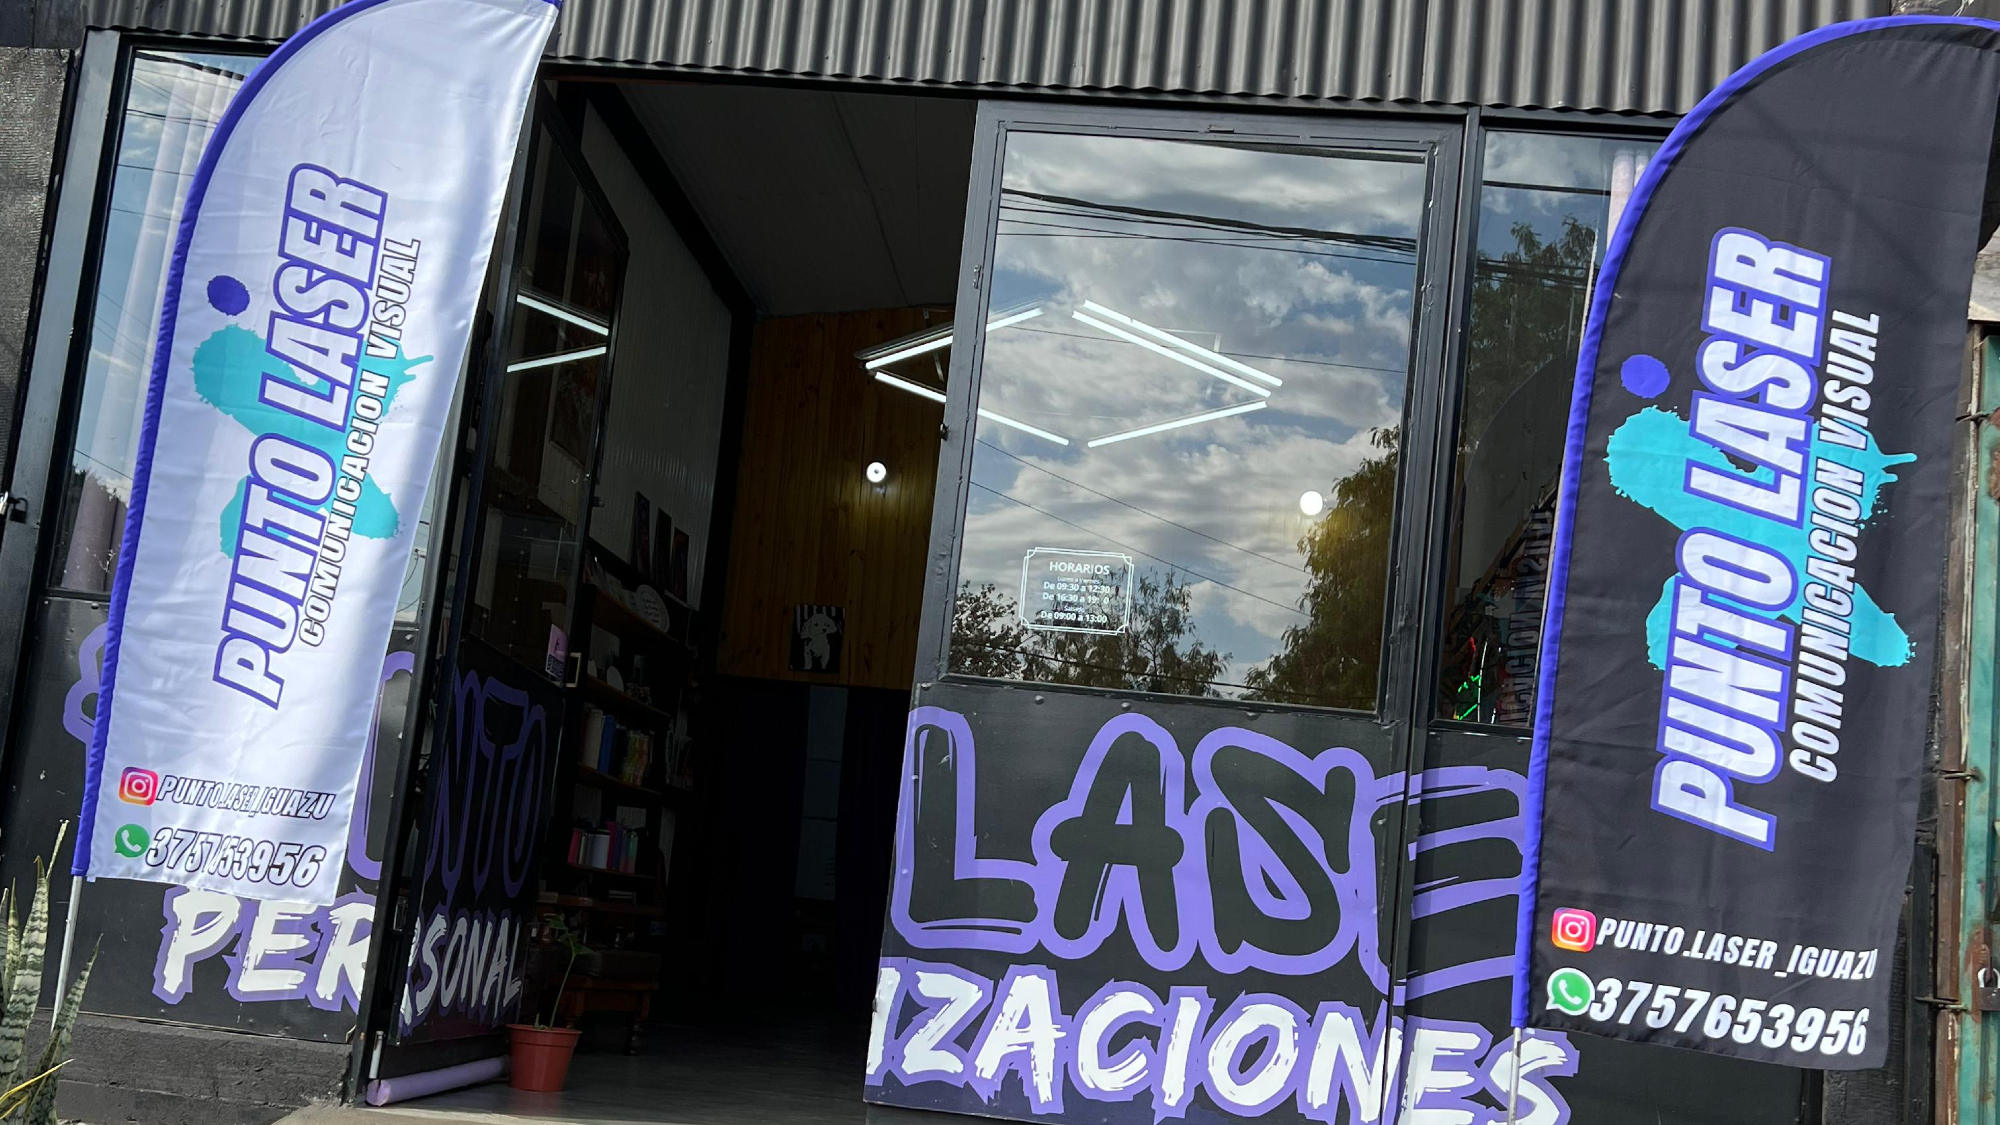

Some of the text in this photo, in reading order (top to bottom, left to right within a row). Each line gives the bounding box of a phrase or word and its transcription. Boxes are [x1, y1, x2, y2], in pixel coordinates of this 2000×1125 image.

[213, 162, 388, 711] PUNTO LASER
[299, 237, 421, 648] COMUNICACION VISUAL
[1040, 610, 1108, 623] De 09:00 a 13:00
[1042, 592, 1110, 605] De 16:30 a 19:0
[1043, 581, 1055, 590] De
[1056, 582, 1079, 591] 09:30
[1088, 584, 1110, 594] 12:30
[1049, 561, 1111, 575] HORARIOS
[1651, 227, 1832, 852] PUNTO LASER
[1789, 309, 1880, 783] COMUNICACION VISUAL
[889, 706, 1530, 1006] LASE
[1588, 977, 1871, 1056] 3757653956
